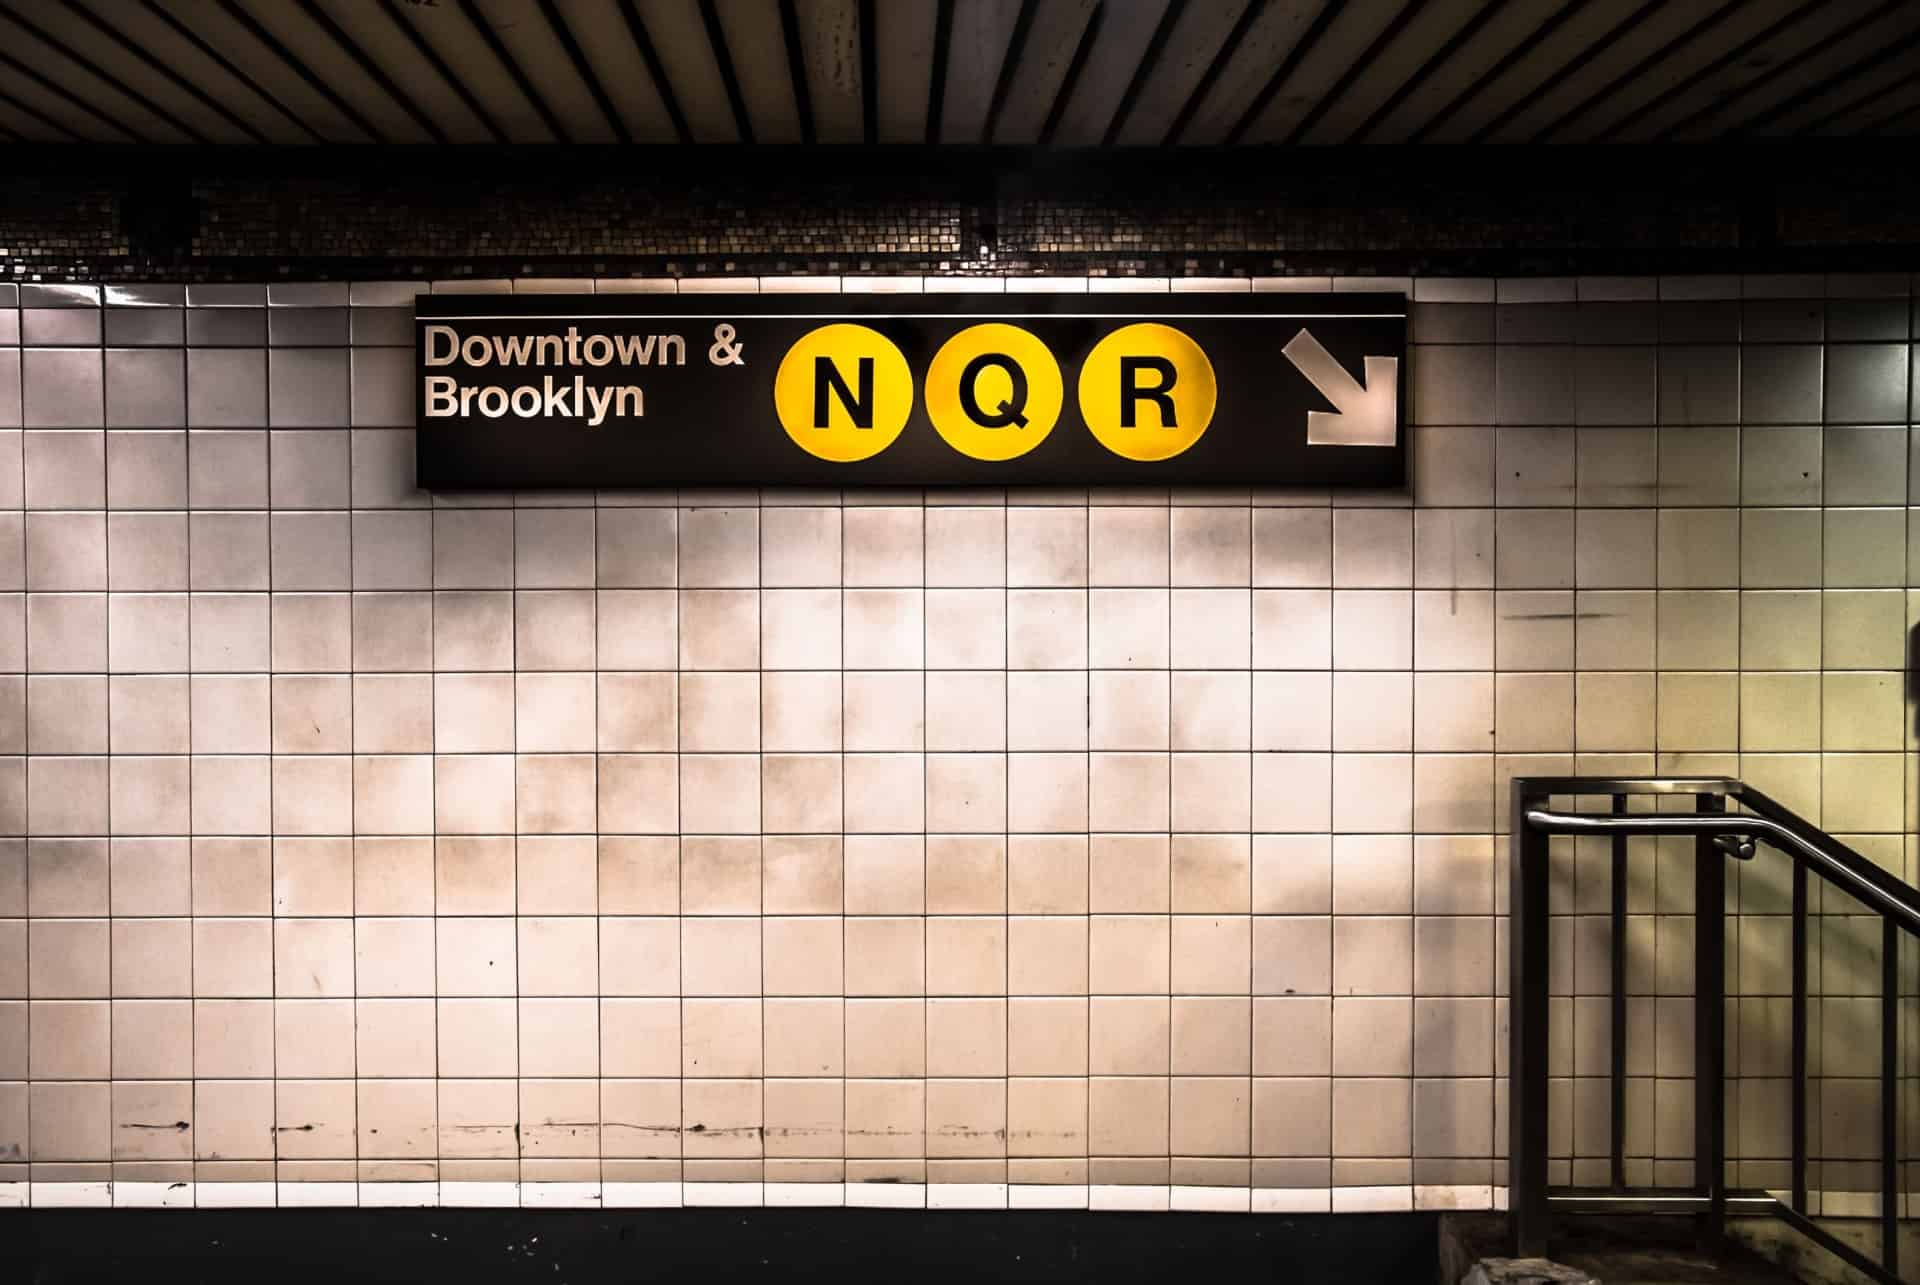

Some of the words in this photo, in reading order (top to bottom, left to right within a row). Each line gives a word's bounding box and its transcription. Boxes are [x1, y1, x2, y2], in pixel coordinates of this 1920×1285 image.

[424, 325, 686, 367] Downtown
[708, 323, 745, 367] &
[424, 375, 644, 427] Brooklyn
[813, 356, 875, 430] N
[958, 352, 1029, 431] Q
[1120, 355, 1179, 430] R
